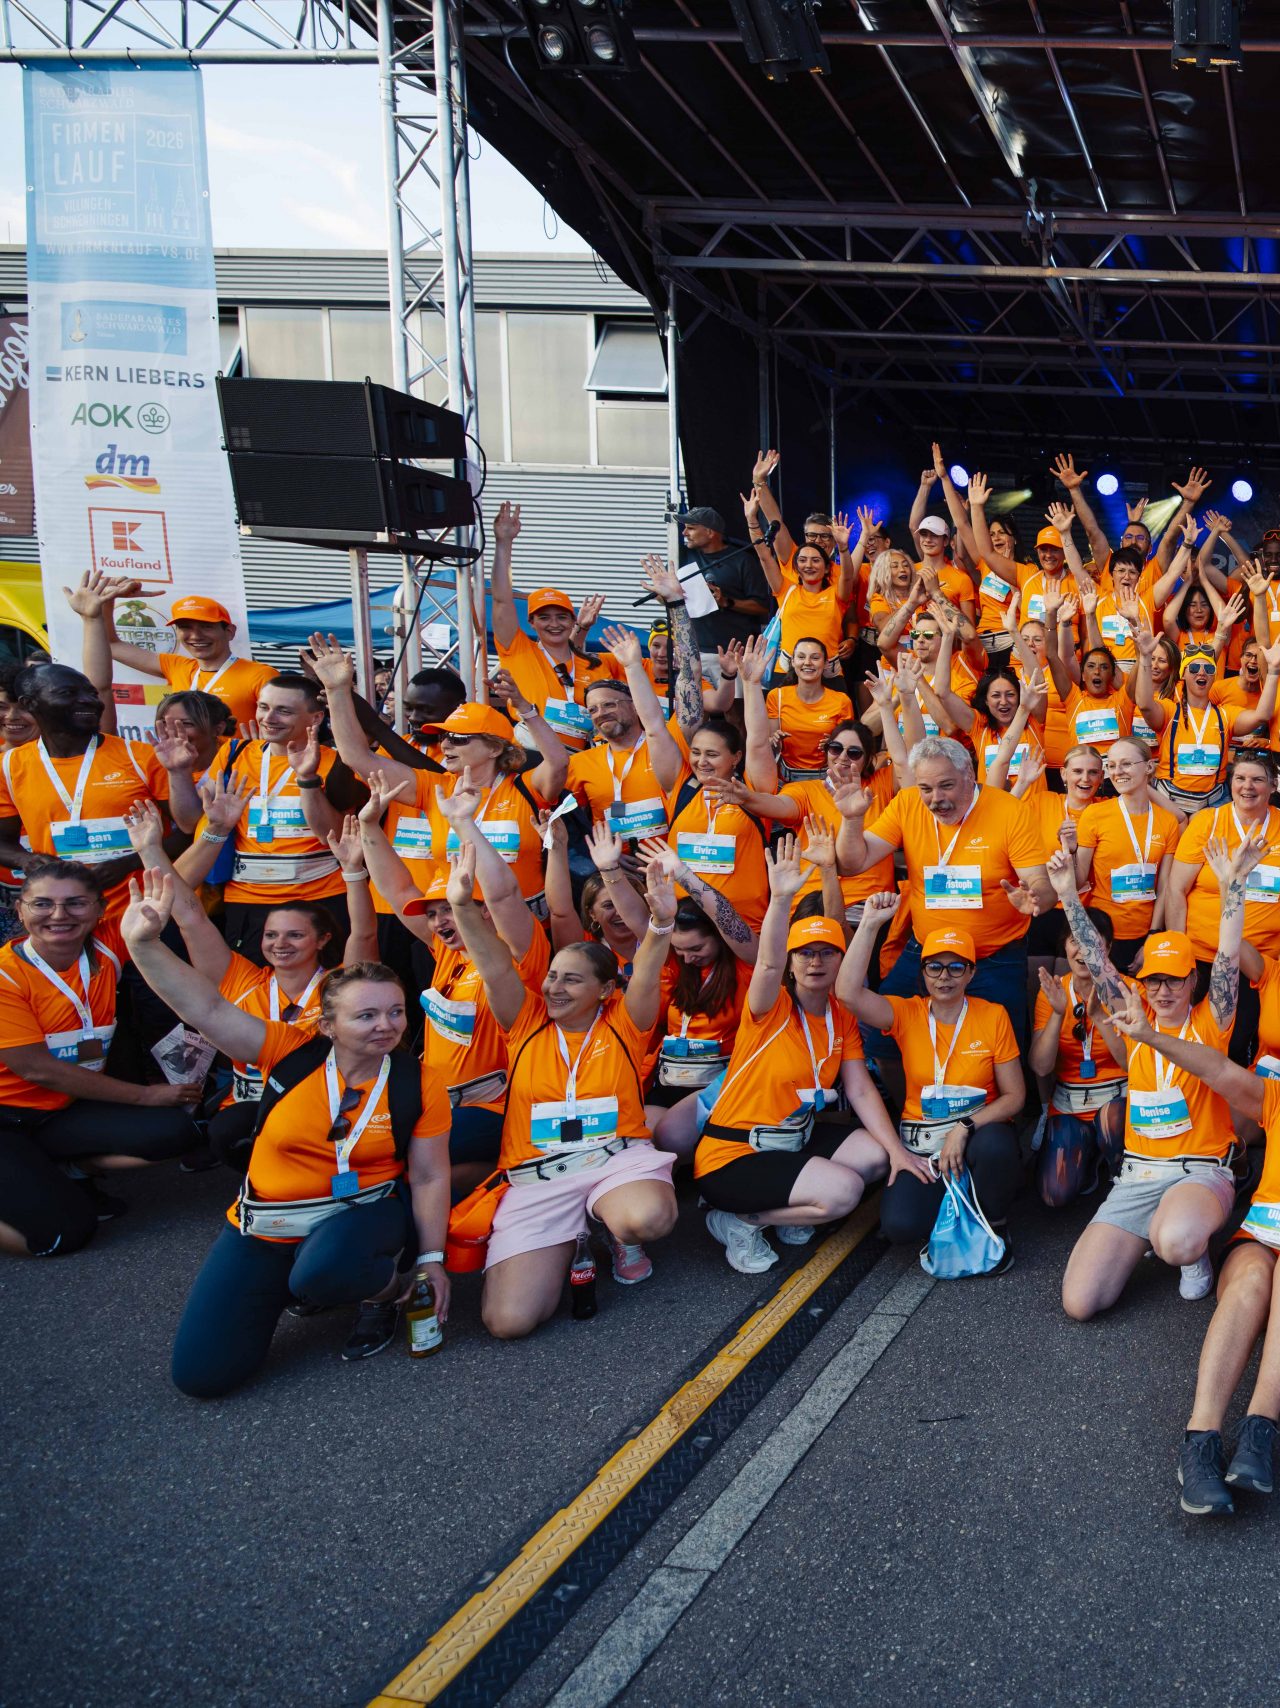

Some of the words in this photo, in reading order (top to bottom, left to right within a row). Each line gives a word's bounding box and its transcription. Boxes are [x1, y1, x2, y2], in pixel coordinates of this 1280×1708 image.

[51, 119, 127, 145] FIRMEN
[146, 129, 185, 150] 2026
[54, 150, 127, 186] LAUF
[63, 197, 117, 212] VILLINGEN-
[53, 211, 130, 229] SCHWENNINGEN
[45, 240, 201, 262] WWW.FIRMENLAUF-VS.DE
[65, 365, 110, 383] KERN
[116, 366, 206, 389] LIEBERS
[71, 402, 134, 429] AOK
[96, 444, 151, 477] dm
[100, 556, 162, 571] Kaufland
[115, 630, 175, 642] ETTERER
[618, 812, 654, 826] Thomas
[87, 831, 112, 843] ean
[692, 845, 718, 856] Elvira
[945, 879, 973, 890] ristoph
[1139, 1105, 1171, 1118] Denise
